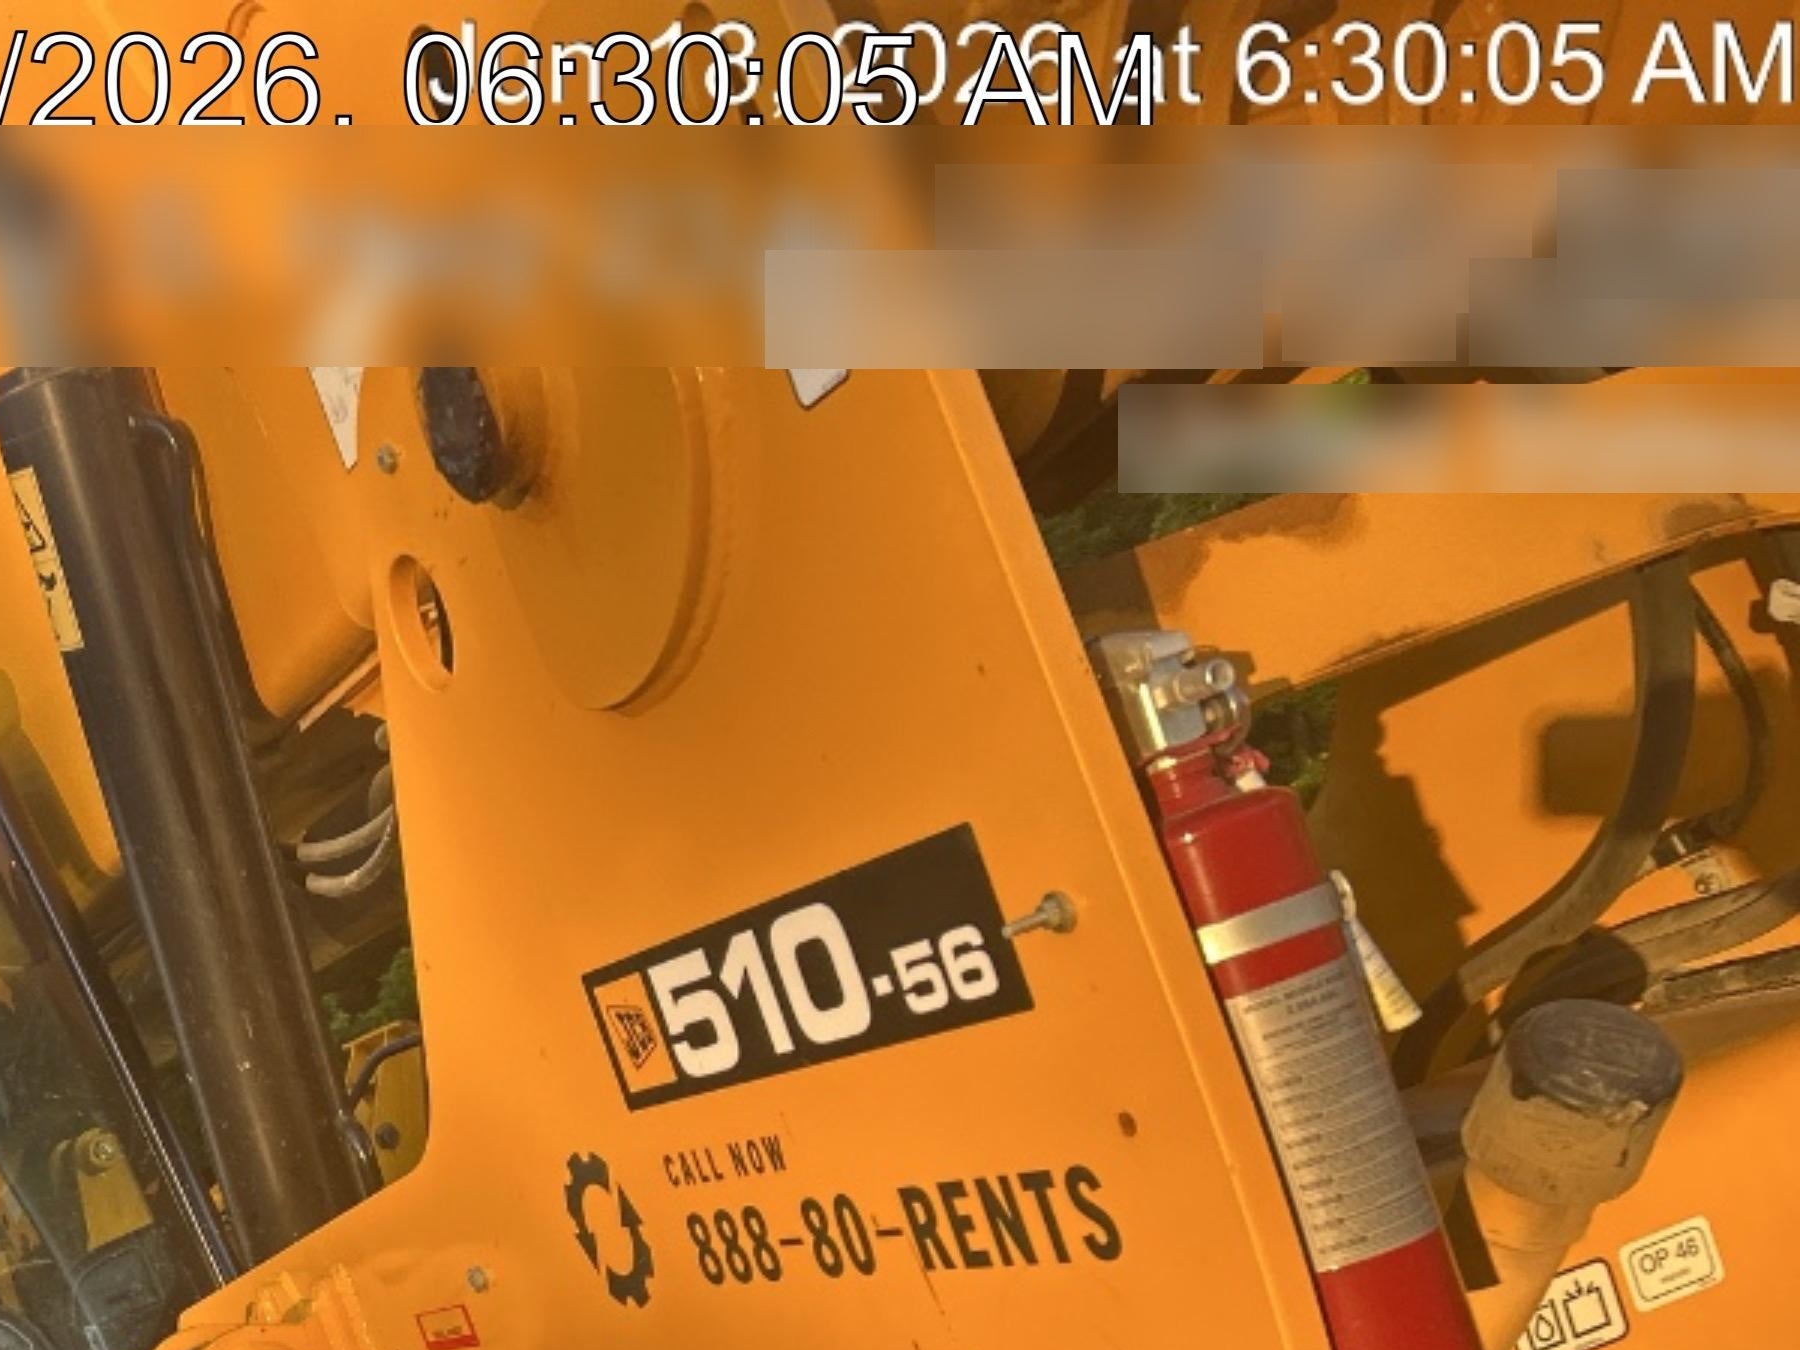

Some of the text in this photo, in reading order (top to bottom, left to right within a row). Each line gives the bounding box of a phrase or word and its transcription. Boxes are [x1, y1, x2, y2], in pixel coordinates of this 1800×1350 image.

[663, 1134, 787, 1188] CALL NOW
[686, 1163, 1124, 1286] 888-80-RENTS
[1640, 1247, 1669, 1275] OP
